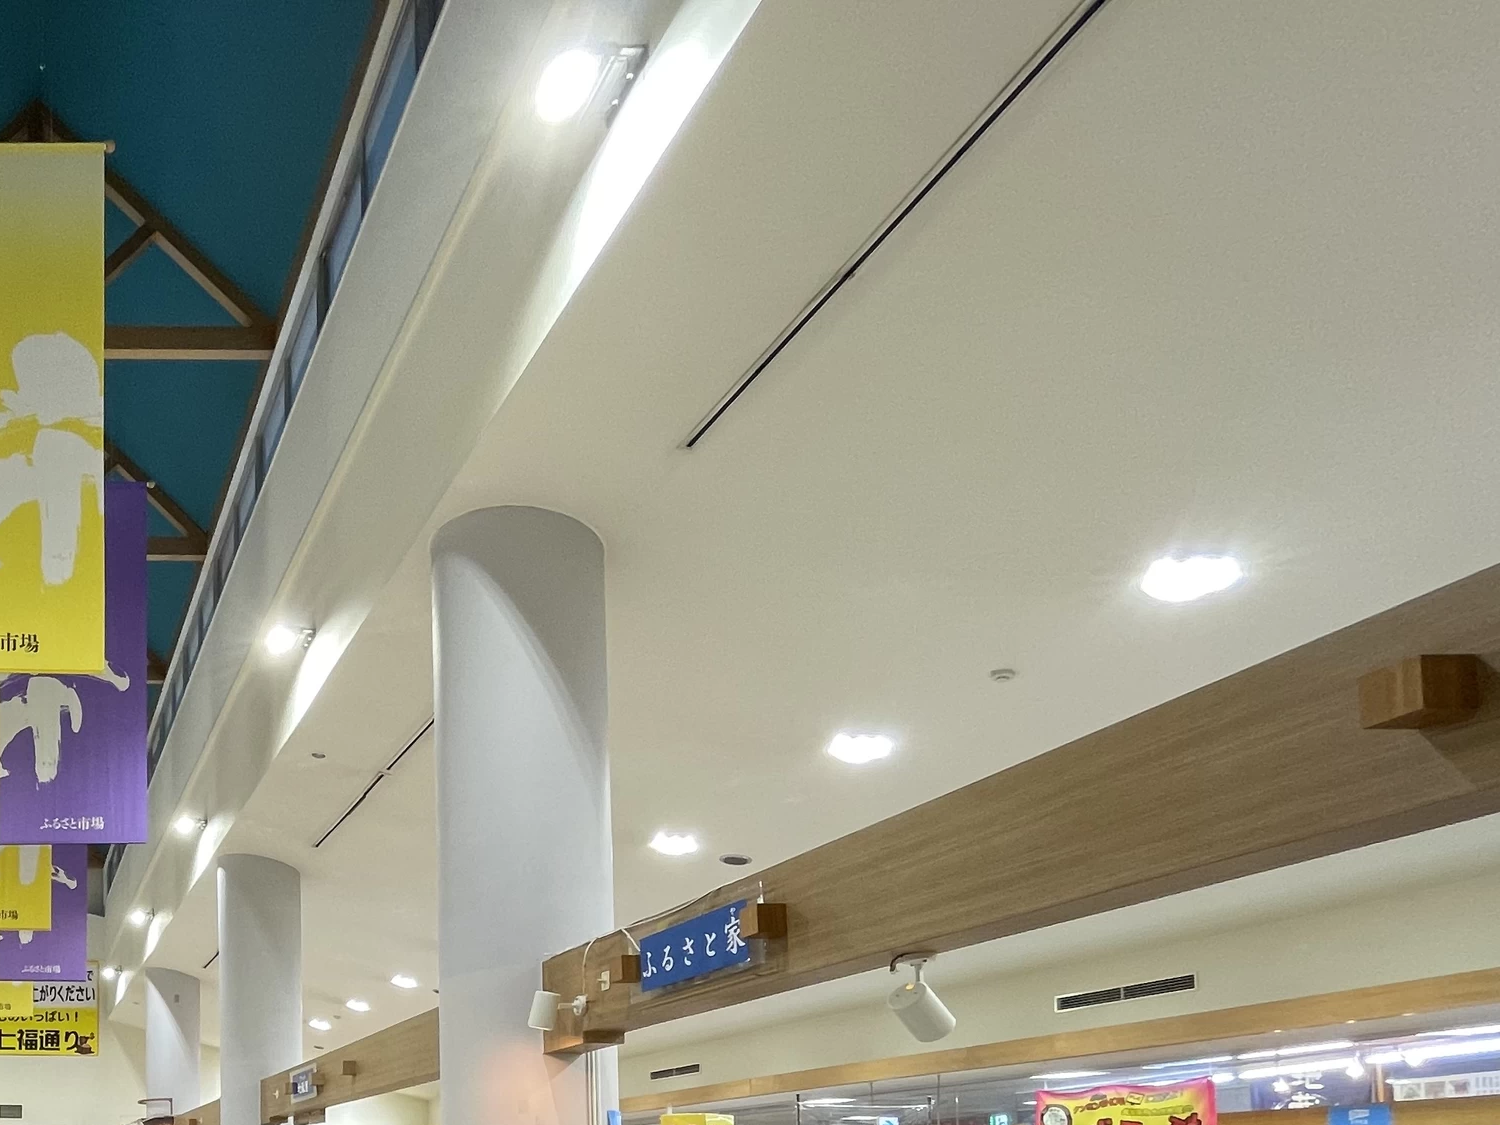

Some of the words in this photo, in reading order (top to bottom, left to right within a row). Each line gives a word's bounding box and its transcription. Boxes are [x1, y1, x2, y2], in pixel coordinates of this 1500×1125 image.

[39, 816, 105, 832] ふるさと市場
[642, 916, 746, 978] ふるさと家
[21, 965, 61, 974] ふるさと市場
